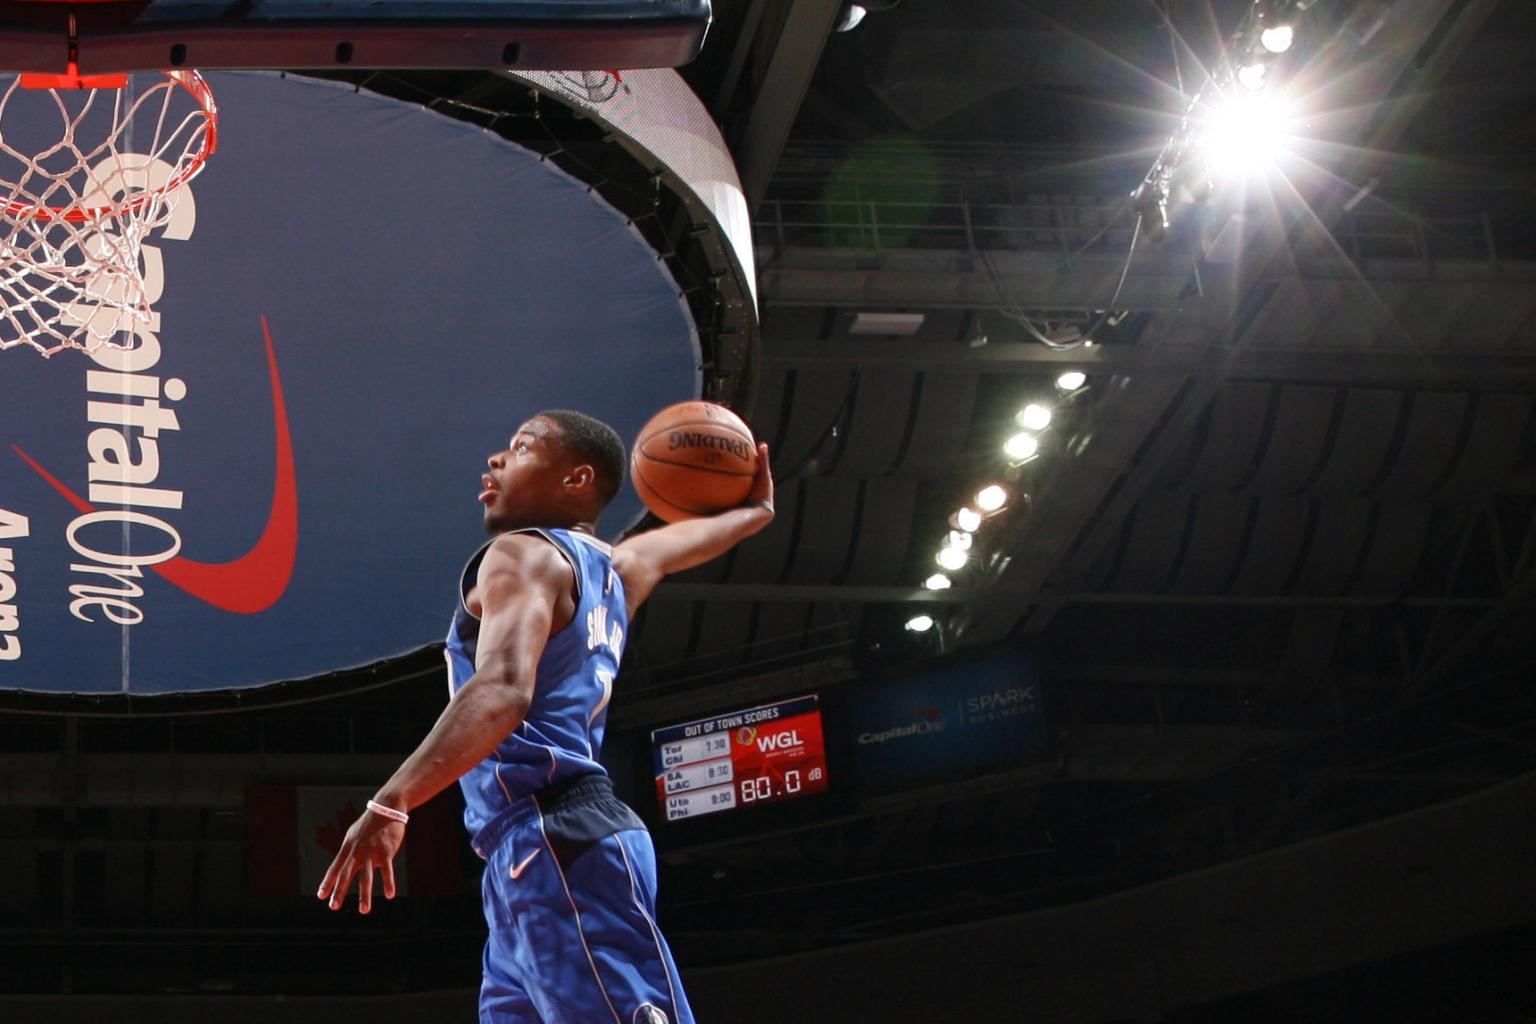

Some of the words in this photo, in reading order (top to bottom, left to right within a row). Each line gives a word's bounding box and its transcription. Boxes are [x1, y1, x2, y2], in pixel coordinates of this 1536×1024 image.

[669, 430, 750, 461] SPALDING
[967, 687, 1033, 712] SPARK
[684, 724, 702, 737] OUT
[704, 721, 715, 732] OF
[717, 715, 743, 731] TOWN
[745, 707, 779, 725] SCORES
[757, 729, 803, 753] WGL
[667, 780, 690, 792] LAC
[741, 770, 801, 802] 80.0
[808, 767, 822, 781] dB
[670, 809, 689, 819] Phi
